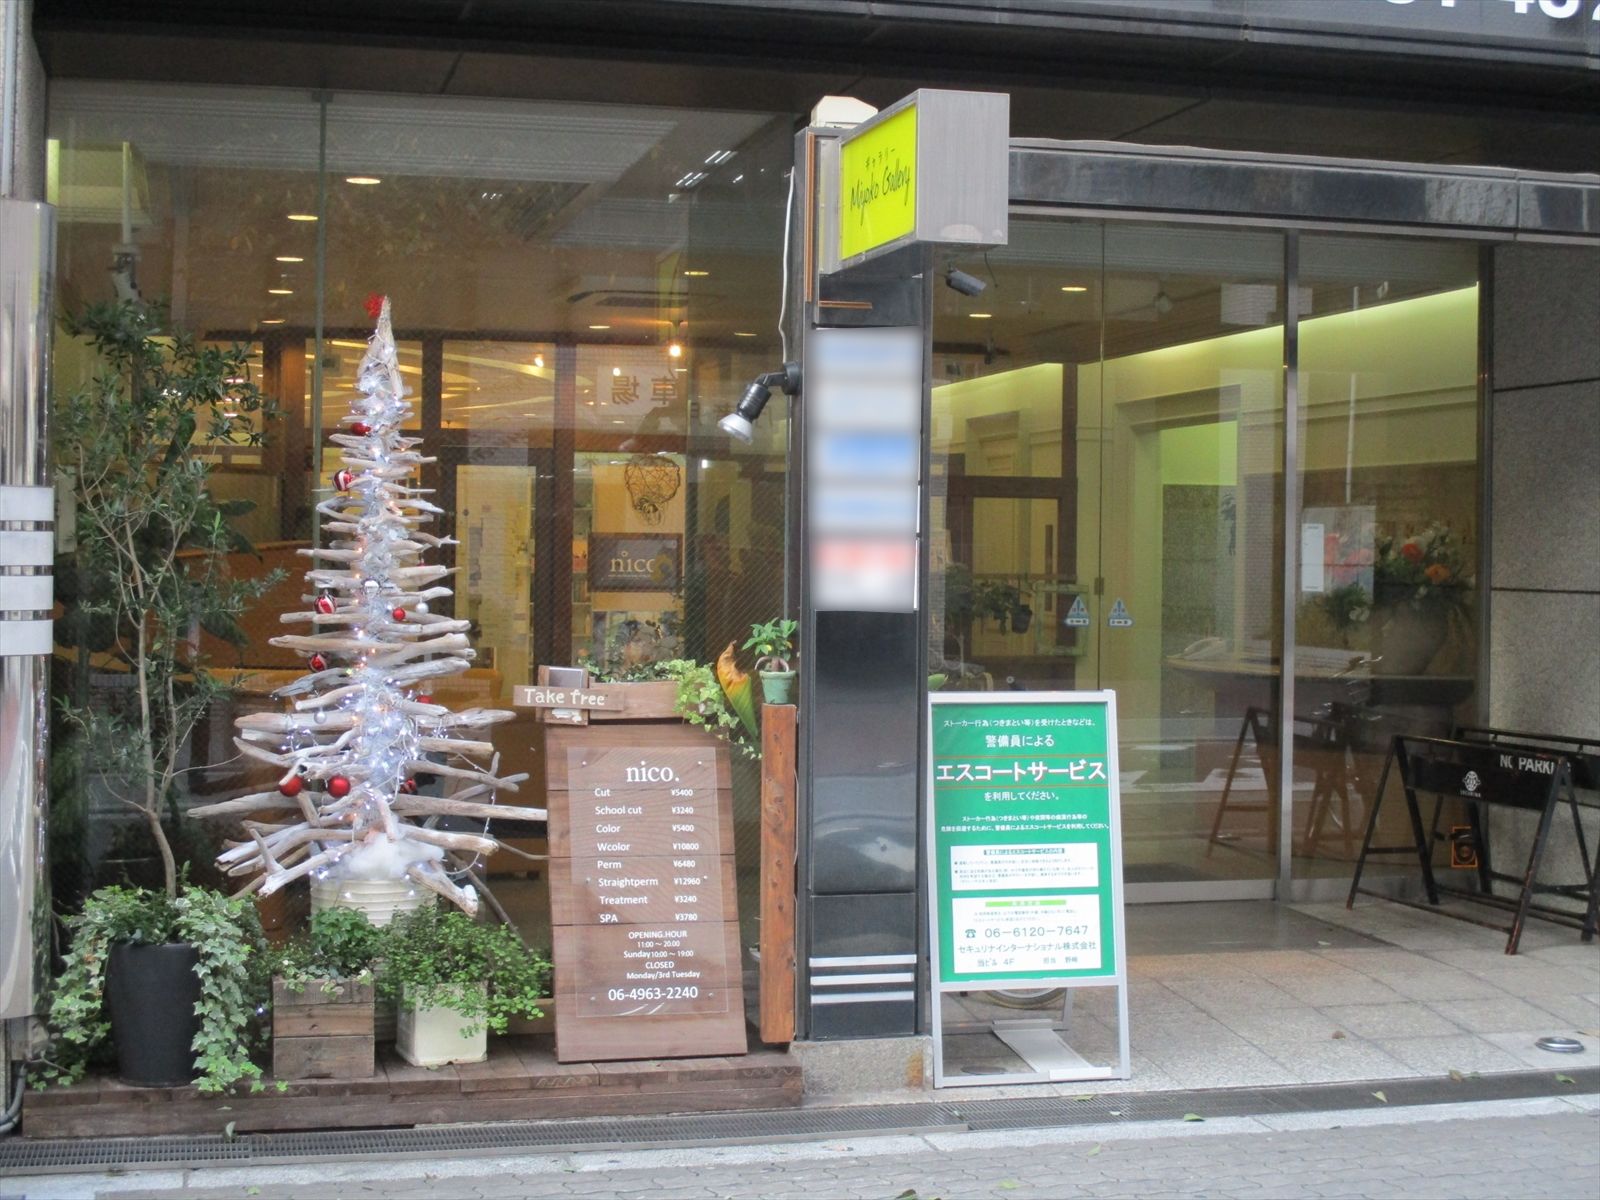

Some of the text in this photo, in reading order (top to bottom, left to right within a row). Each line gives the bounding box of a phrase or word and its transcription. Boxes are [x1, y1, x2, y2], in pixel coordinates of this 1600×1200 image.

[524, 688, 605, 706] Take free
[985, 734, 1055, 748] 警備員による
[626, 760, 680, 782] nico.
[936, 759, 1107, 782] エスコートサービス
[594, 788, 611, 797] Cut
[984, 791, 1060, 801] を利用してください。
[595, 805, 626, 815] School
[627, 806, 643, 815] cut
[596, 824, 621, 833] Color
[597, 842, 630, 851] Wcolor
[597, 860, 622, 869] Perm
[598, 877, 659, 889] Straightperm
[599, 895, 648, 905] Treatment
[599, 913, 618, 923] SPA
[645, 961, 675, 969] CLOSED
[672, 970, 700, 979] Tuesday
[608, 986, 698, 1001] 06-4963-2240
